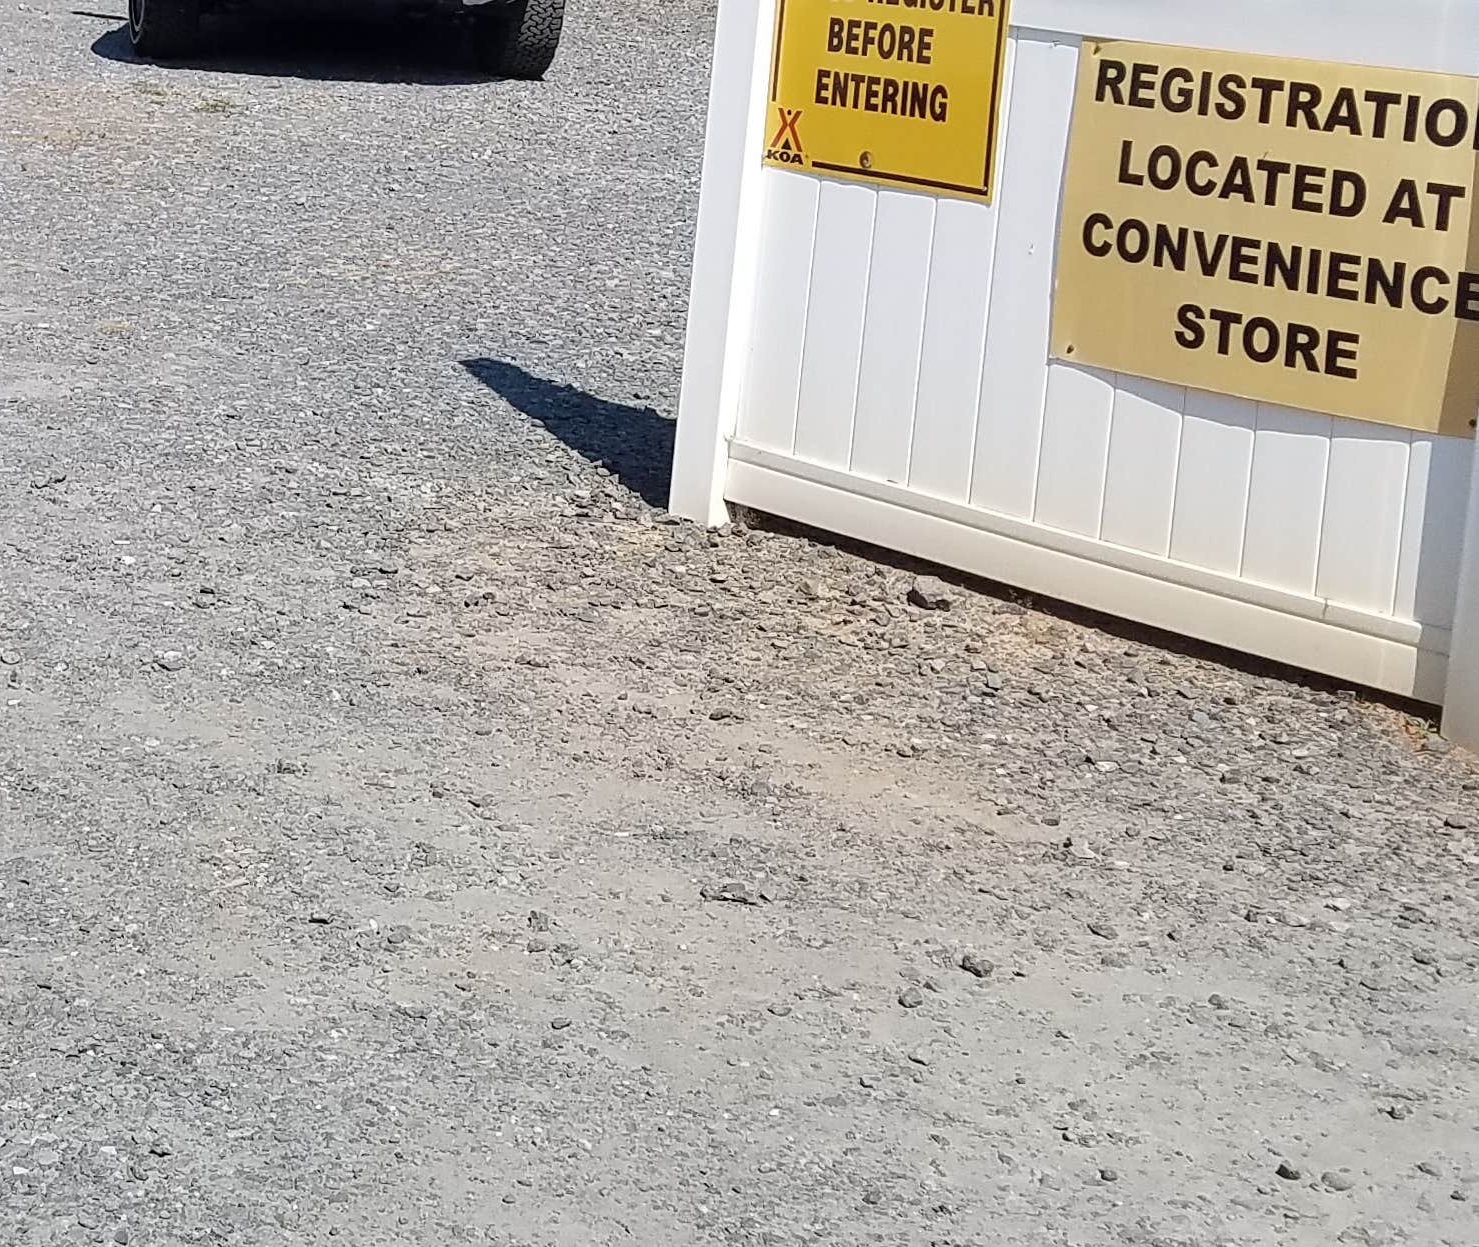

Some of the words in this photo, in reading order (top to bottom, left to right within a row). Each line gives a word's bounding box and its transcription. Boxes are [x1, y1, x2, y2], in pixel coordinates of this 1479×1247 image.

[827, 17, 934, 64] BEFORE
[814, 68, 949, 123] ENTERING
[766, 149, 804, 166] KOA
[1117, 139, 1367, 218] LOCATED
[1381, 178, 1466, 232] AT
[1082, 213, 1479, 321] CONVENIENCE
[1174, 303, 1360, 380] STORE
